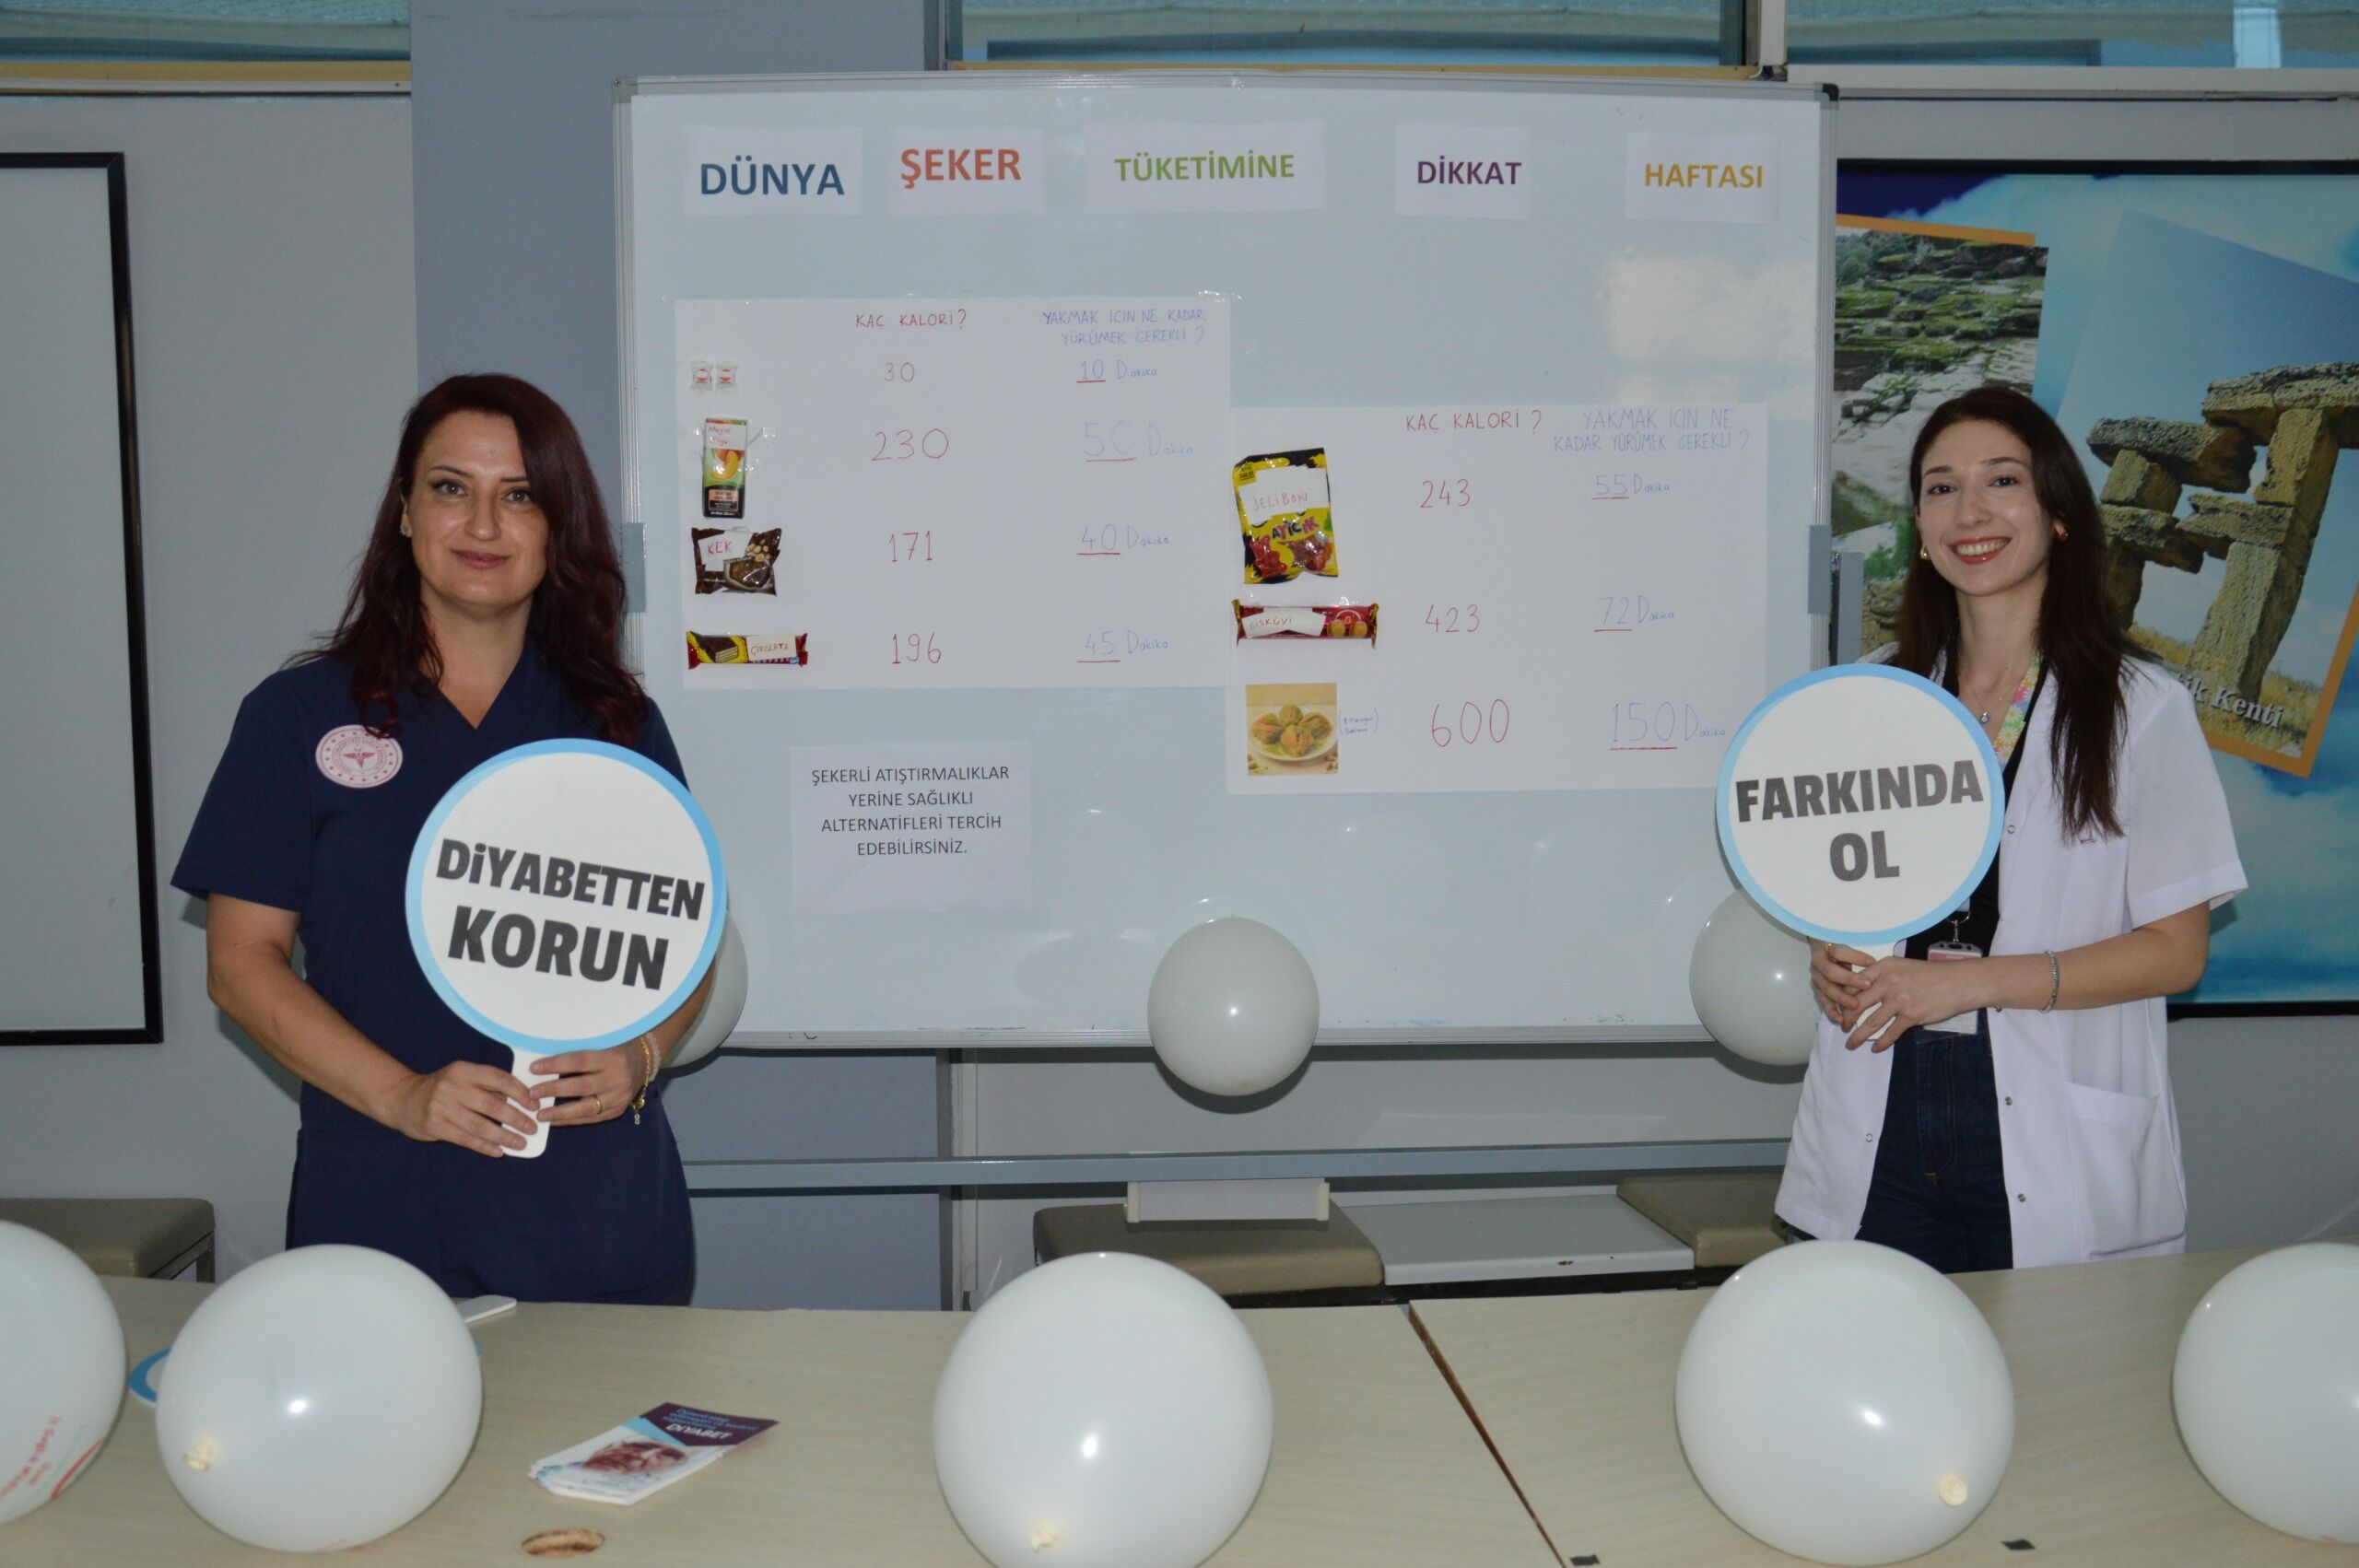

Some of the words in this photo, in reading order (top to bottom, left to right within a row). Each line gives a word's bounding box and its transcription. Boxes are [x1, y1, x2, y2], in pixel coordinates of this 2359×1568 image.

[700, 155, 845, 196] DÜNYA
[900, 148, 1022, 189] ŞEKER
[1114, 149, 1295, 182] TÜKETİMİNE
[1417, 154, 1522, 185] DİKKAT
[1644, 163, 1764, 190] HAFTASI
[1042, 310, 1098, 324] YAKMAK
[1142, 309, 1157, 322] NE
[1168, 309, 1206, 322] KADAR
[1062, 329, 1126, 345] YÜRÜMEK
[884, 361, 915, 383] 30
[1081, 359, 1104, 380] 10
[1583, 408, 1659, 429] YAKMAK
[1710, 408, 1733, 428] NE
[872, 427, 949, 462] 230
[1084, 420, 1135, 457] 50
[1554, 434, 1602, 451] KADAR
[1612, 430, 1666, 451] YÜRÜMEK
[1419, 478, 1472, 509] 243
[1595, 474, 1628, 496] 55
[708, 540, 733, 555] KEK
[888, 530, 934, 563] 171
[1081, 524, 1118, 551] 40
[1425, 603, 1481, 633] 423
[1600, 596, 1631, 626] 72
[892, 632, 942, 665] 196
[1085, 629, 1115, 655] 45
[2211, 686, 2285, 728] Kenti
[1431, 698, 1510, 747] 600
[1611, 701, 1676, 743] 150
[812, 766, 871, 786] ŞEKERLİ
[875, 766, 1009, 785] ATIŞTIRMALIKLAR
[849, 790, 902, 807] YERİNE
[908, 790, 973, 806] SAĞLIKLI
[1736, 760, 1984, 823] FARKINDA
[821, 813, 943, 832] ALTERNATİFLERİ
[947, 813, 1002, 829] TERCİH
[858, 838, 967, 856] EDEBİLİRSİNİZ.
[1830, 830, 1900, 882] OL
[448, 906, 669, 990] KORUN
